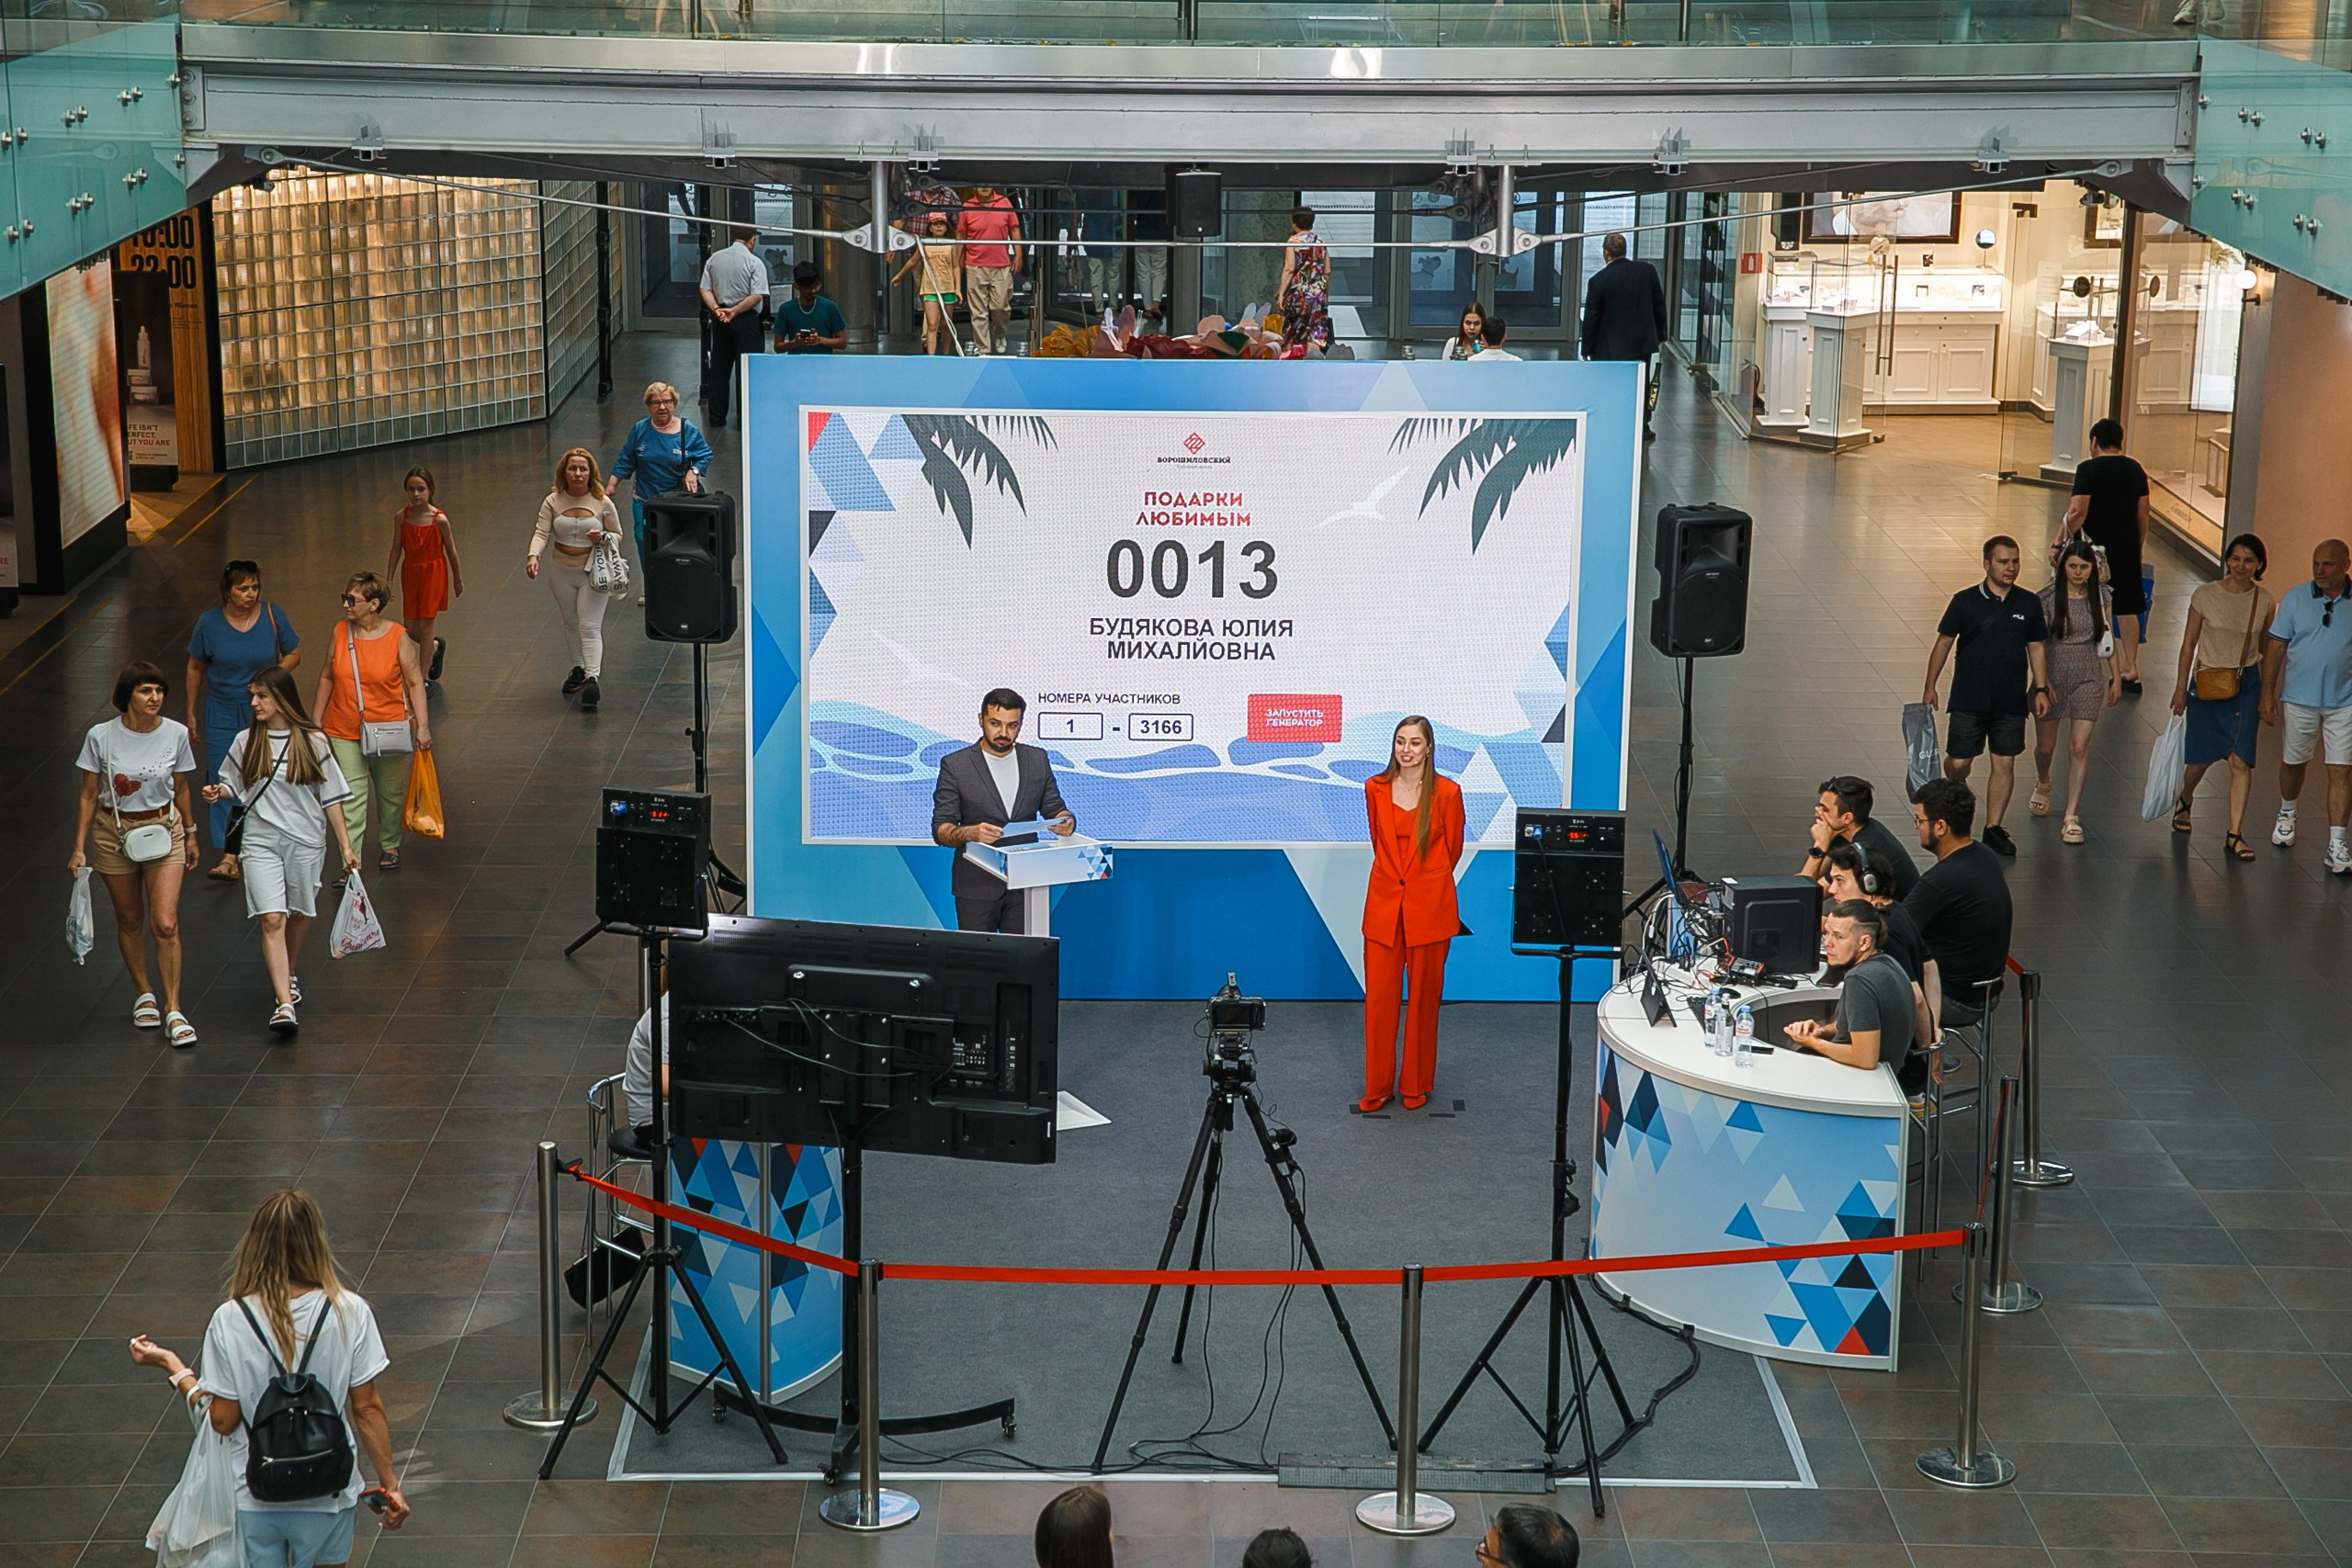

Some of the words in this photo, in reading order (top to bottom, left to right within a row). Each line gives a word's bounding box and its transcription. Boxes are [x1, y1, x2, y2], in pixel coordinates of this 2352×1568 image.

[1144, 491, 1243, 508] ПОДАРКИ
[1136, 511, 1251, 526] ЛЮБИМЫМ
[610, 549, 622, 591] ALWAYS
[1106, 539, 1278, 599] 0013
[1090, 617, 1215, 638] БУДЯКОВА
[1223, 619, 1293, 637] ЮЛИЯ
[1108, 637, 1276, 660] МИХАЛЙОВНА
[1038, 693, 1091, 704] НОМЕРА
[1095, 694, 1181, 705] УЧАСТНИКОВ
[1266, 709, 1324, 717] ЗАПУСТИТЬ
[1066, 719, 1074, 733] 1
[1140, 720, 1182, 734] 3166
[1266, 718, 1323, 727] ГЕНЕРАТОР
